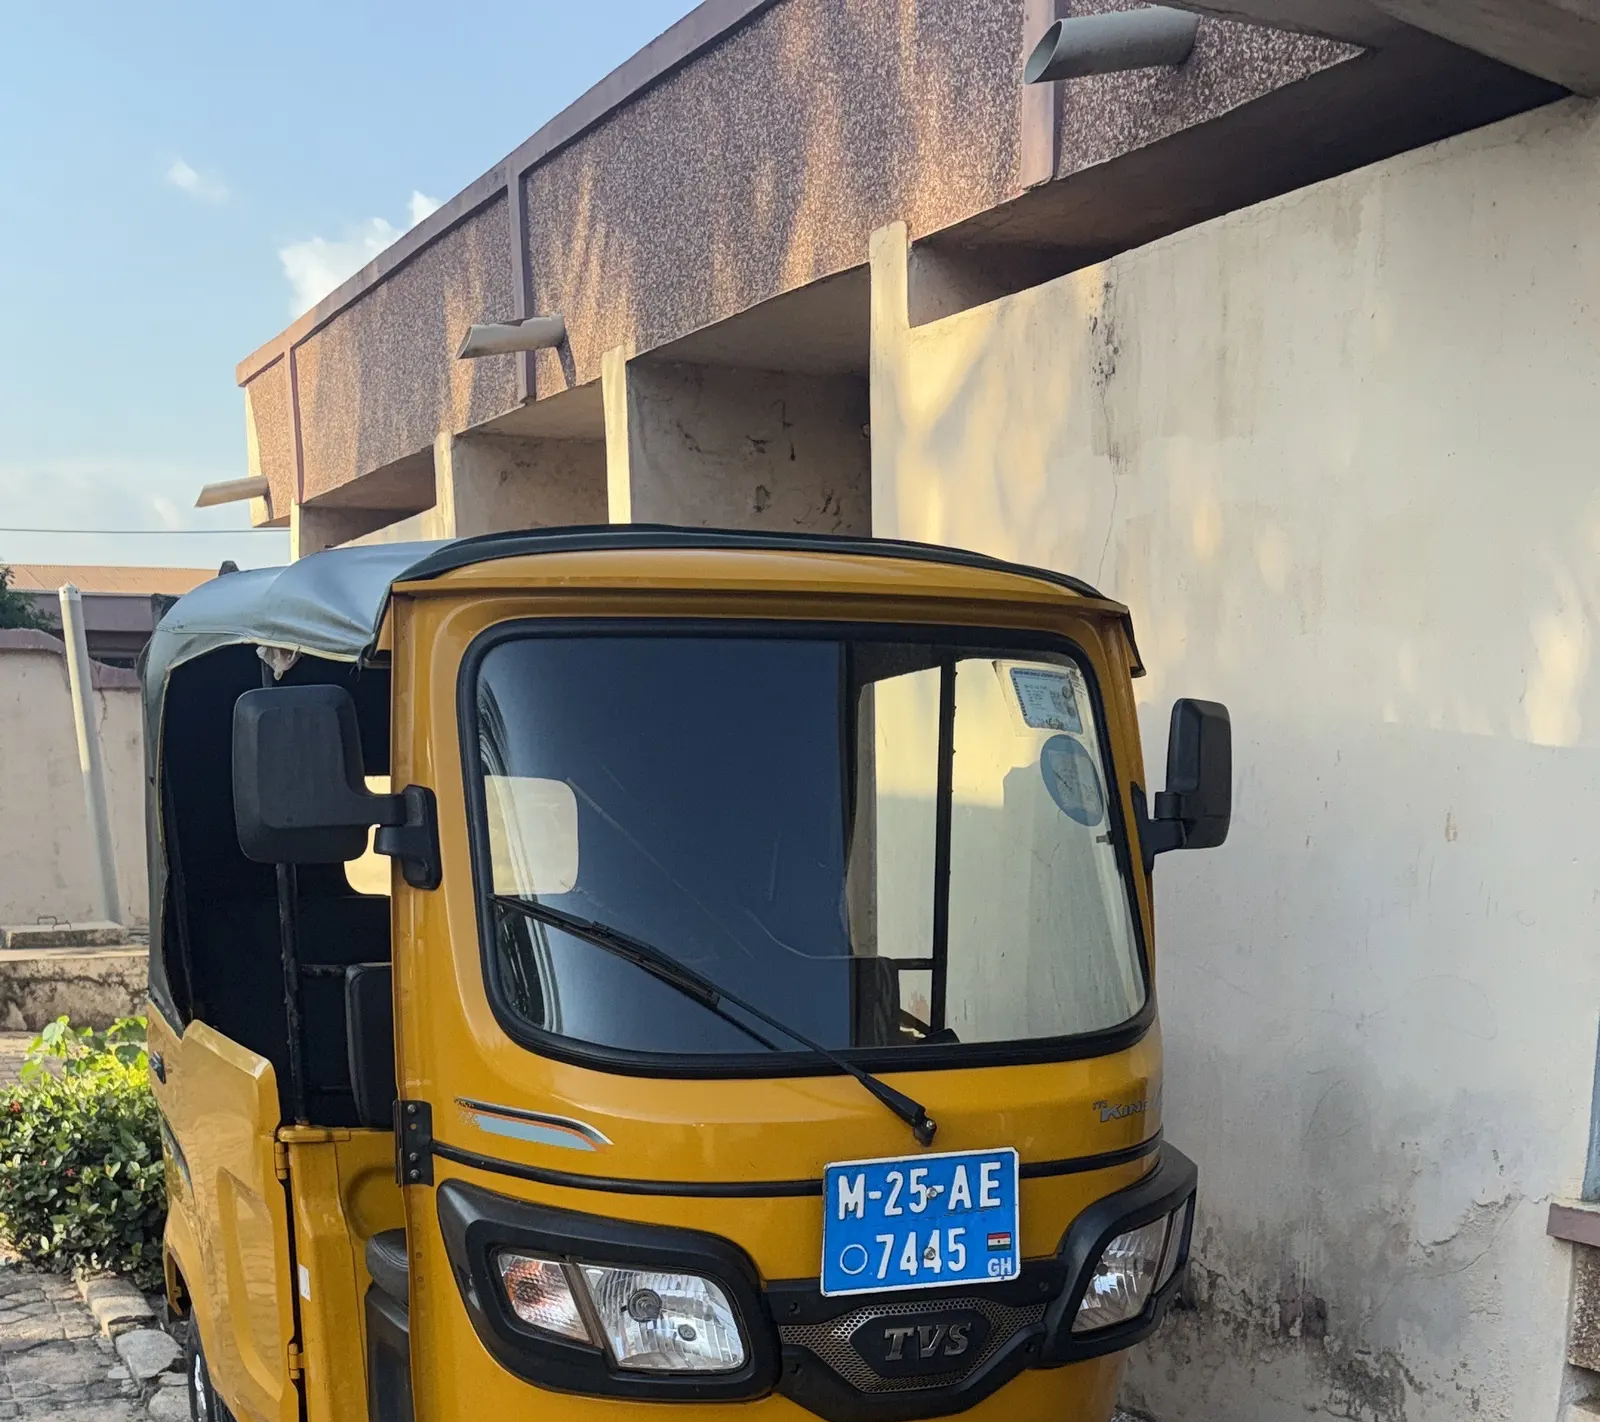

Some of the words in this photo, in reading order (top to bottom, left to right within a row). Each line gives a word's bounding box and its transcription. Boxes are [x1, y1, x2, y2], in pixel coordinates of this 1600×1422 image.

[838, 1161, 1002, 1220] M-25-AE
[875, 1227, 966, 1279] 7445
[987, 1256, 1012, 1276] GH
[883, 1322, 972, 1361] TVS
